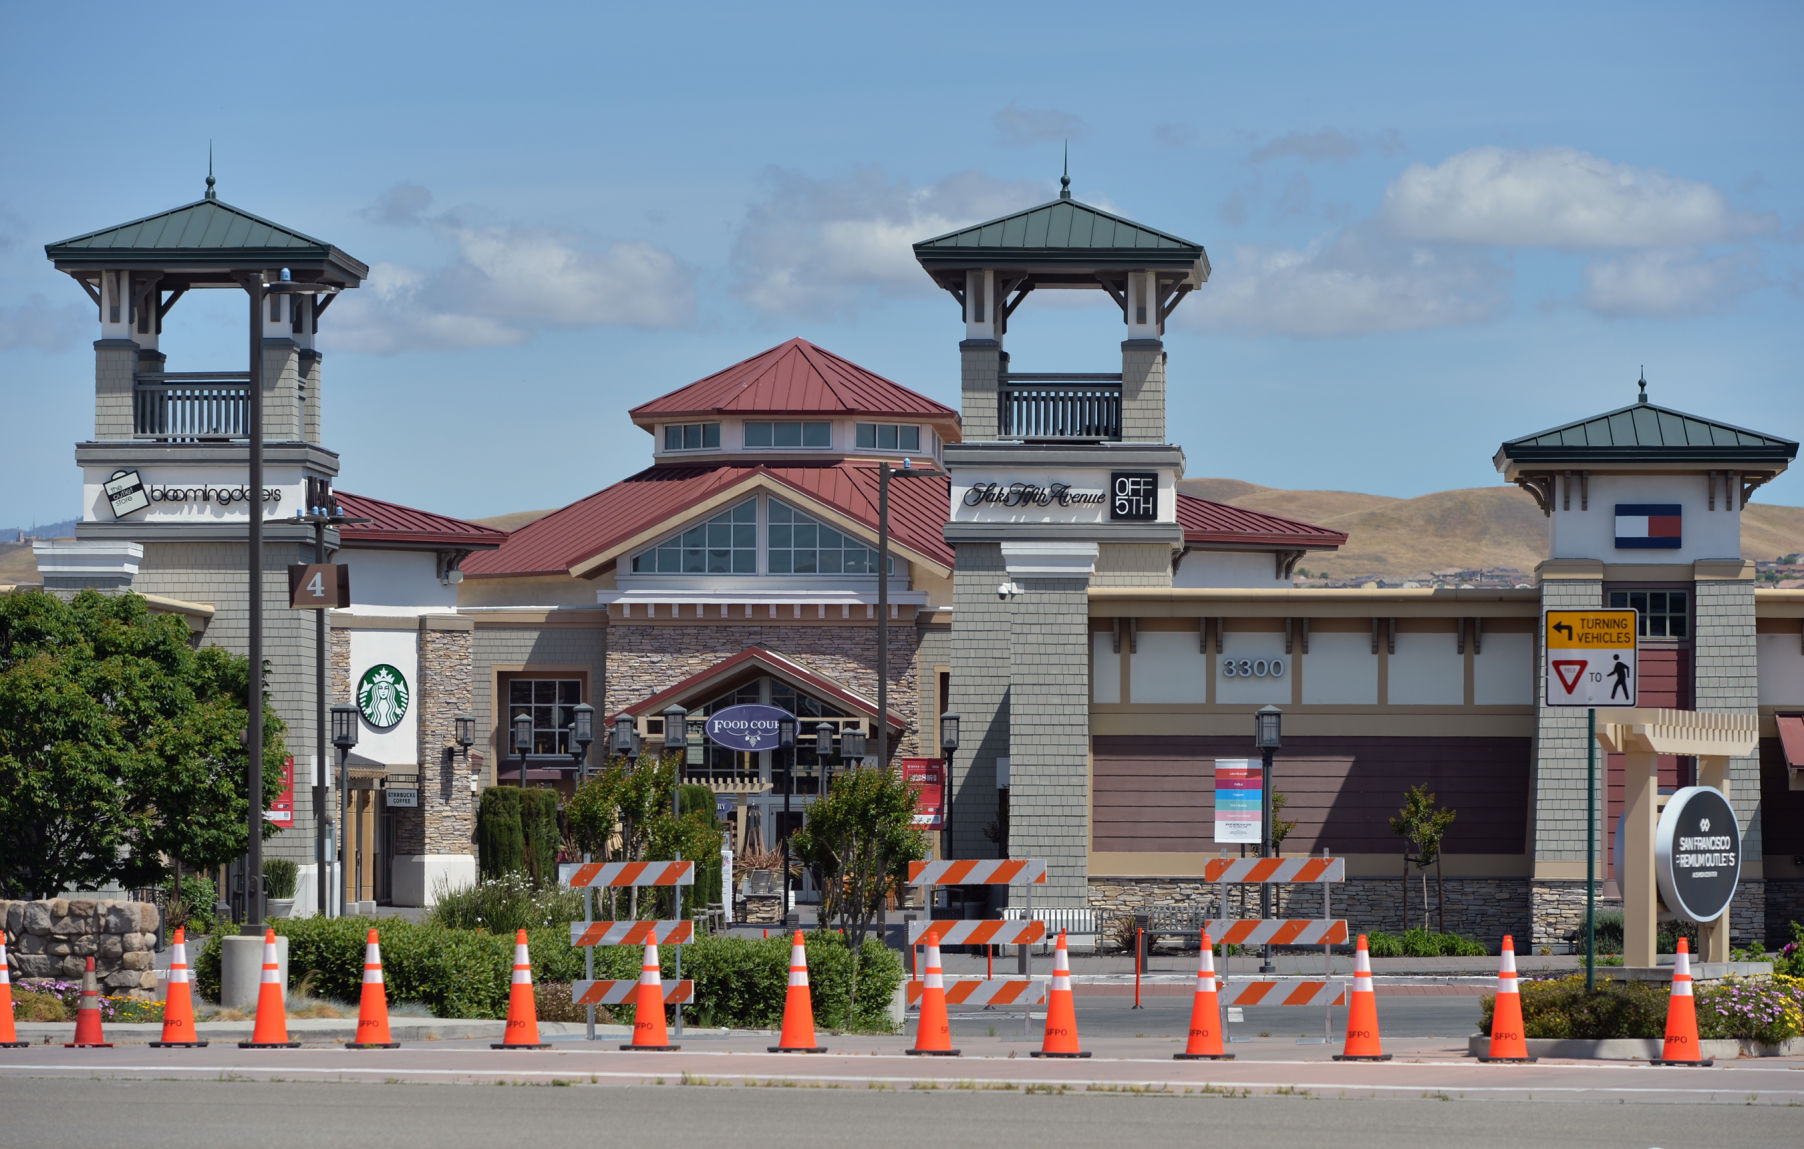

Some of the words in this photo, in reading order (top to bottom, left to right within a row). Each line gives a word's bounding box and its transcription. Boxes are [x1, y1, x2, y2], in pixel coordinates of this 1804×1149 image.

[110, 485, 123, 493] the
[1115, 477, 1153, 496] OFF
[113, 487, 134, 501] outlet
[150, 484, 282, 506] bloomingde's
[964, 482, 1010, 507] Saks
[1004, 482, 1047, 507] Fifth
[1038, 482, 1106, 507] Avenue
[115, 496, 133, 507] store
[1115, 496, 1153, 515] 5TH
[306, 572, 325, 597] 4
[1580, 618, 1628, 629] TURNING
[1577, 632, 1631, 644] VEHICLES
[1223, 659, 1285, 677] 3300
[1589, 672, 1602, 683] TO
[713, 720, 748, 733] FOOD
[1679, 836, 1694, 851] SAN
[1694, 836, 1731, 850] FRANCISCO
[1676, 854, 1705, 868] PREMIUM
[1705, 853, 1736, 867] OUTLETS
[1348, 1030, 1370, 1039] SFPO
[1494, 1032, 1518, 1040] SFPO
